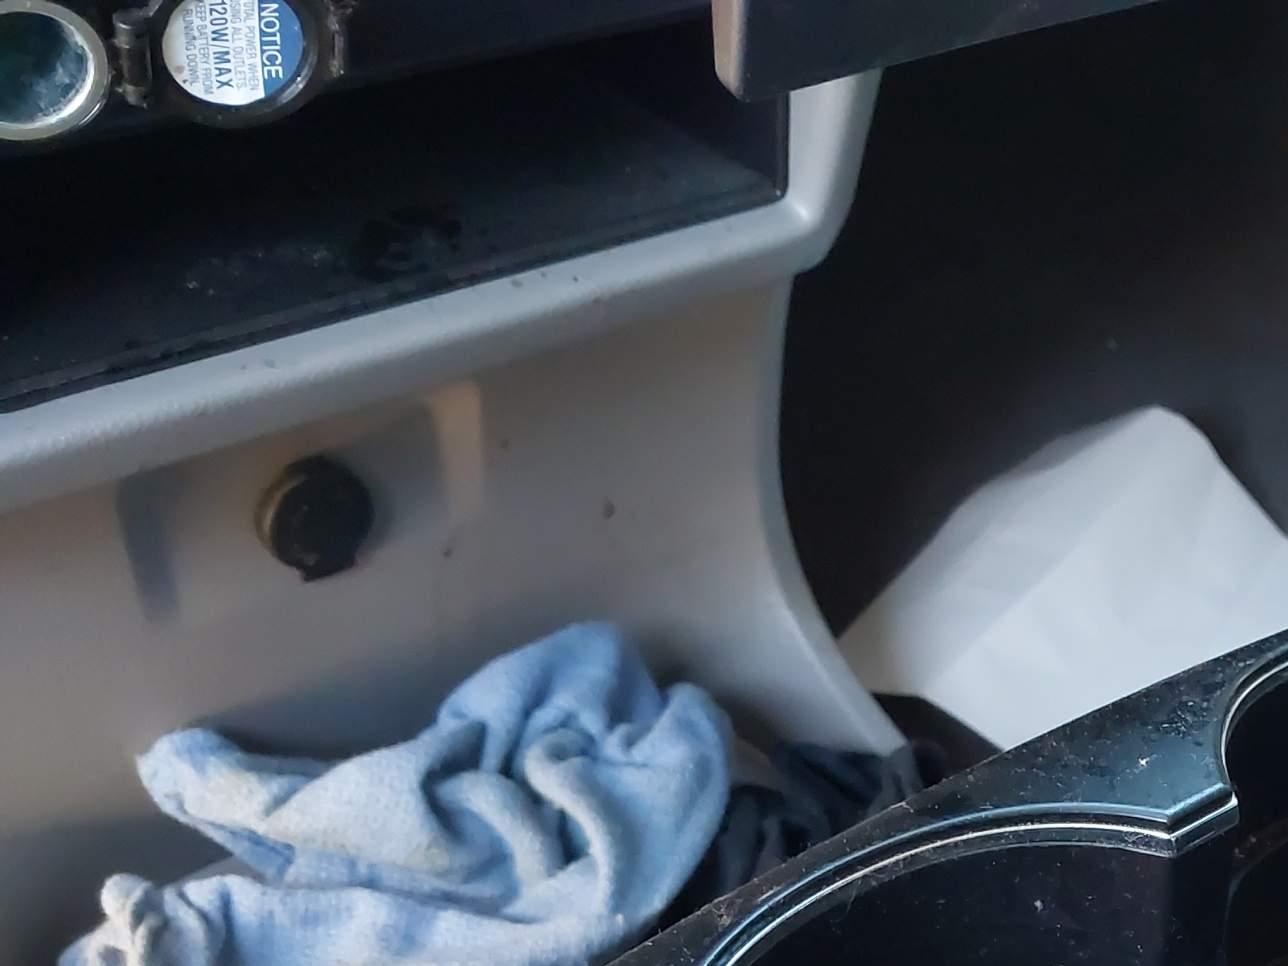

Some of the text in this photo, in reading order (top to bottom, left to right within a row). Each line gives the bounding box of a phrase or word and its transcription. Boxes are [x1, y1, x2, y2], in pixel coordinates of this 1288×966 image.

[183, 9, 197, 51] RUNNING
[196, 24, 210, 65] BATTERY
[209, 0, 234, 89] 120W/MAX
[231, 26, 243, 43] ALL
[243, 0, 260, 91] OTAL POWER WHEN
[260, 3, 284, 80] NOTICE
[201, 68, 214, 95] FROM
